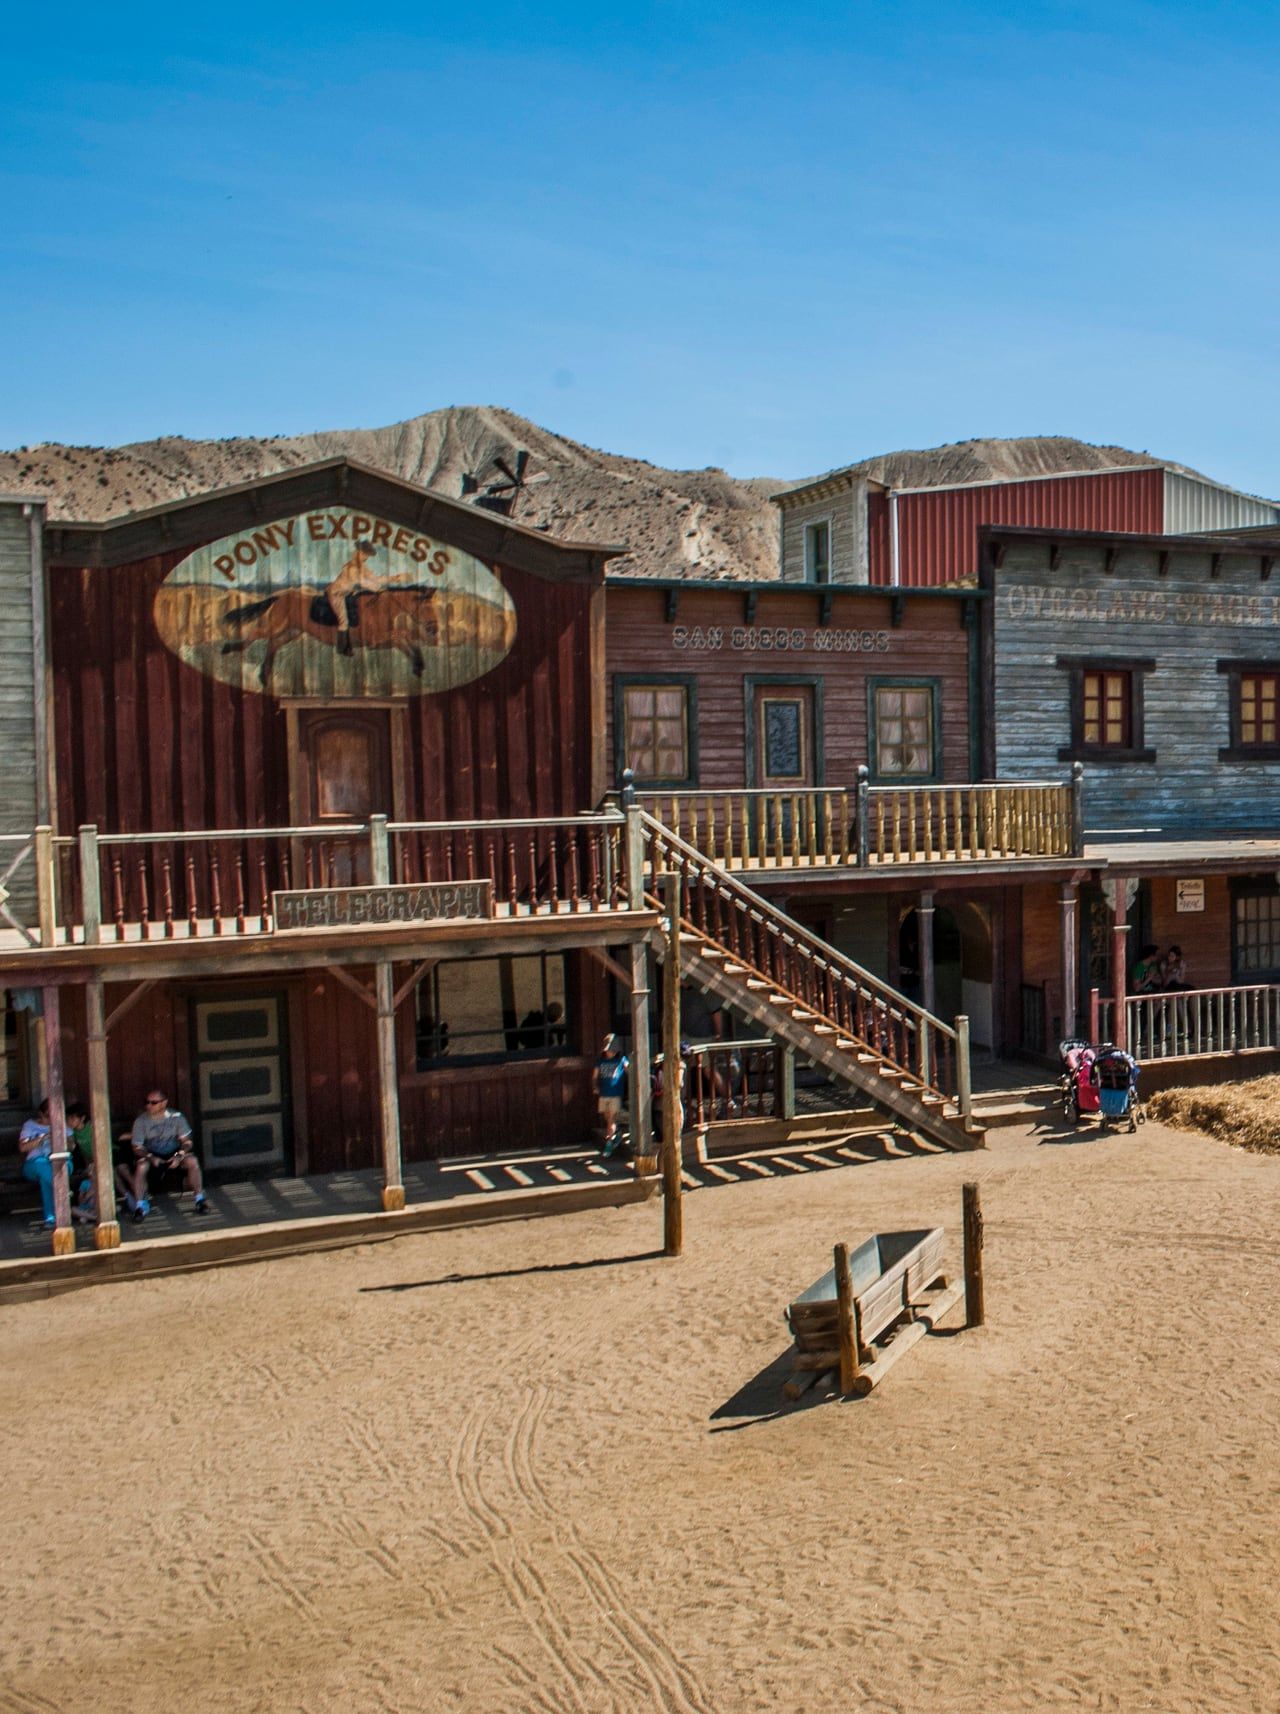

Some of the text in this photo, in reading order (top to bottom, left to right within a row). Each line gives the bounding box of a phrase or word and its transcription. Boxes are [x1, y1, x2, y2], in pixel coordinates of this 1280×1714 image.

[213, 513, 451, 582] PONY EXPRESS
[1006, 585, 1168, 622] OVERLAND
[1175, 591, 1263, 625] STAGE
[672, 626, 891, 652] SAN DIEGO MINES
[283, 886, 481, 927] TELEGRAPH
